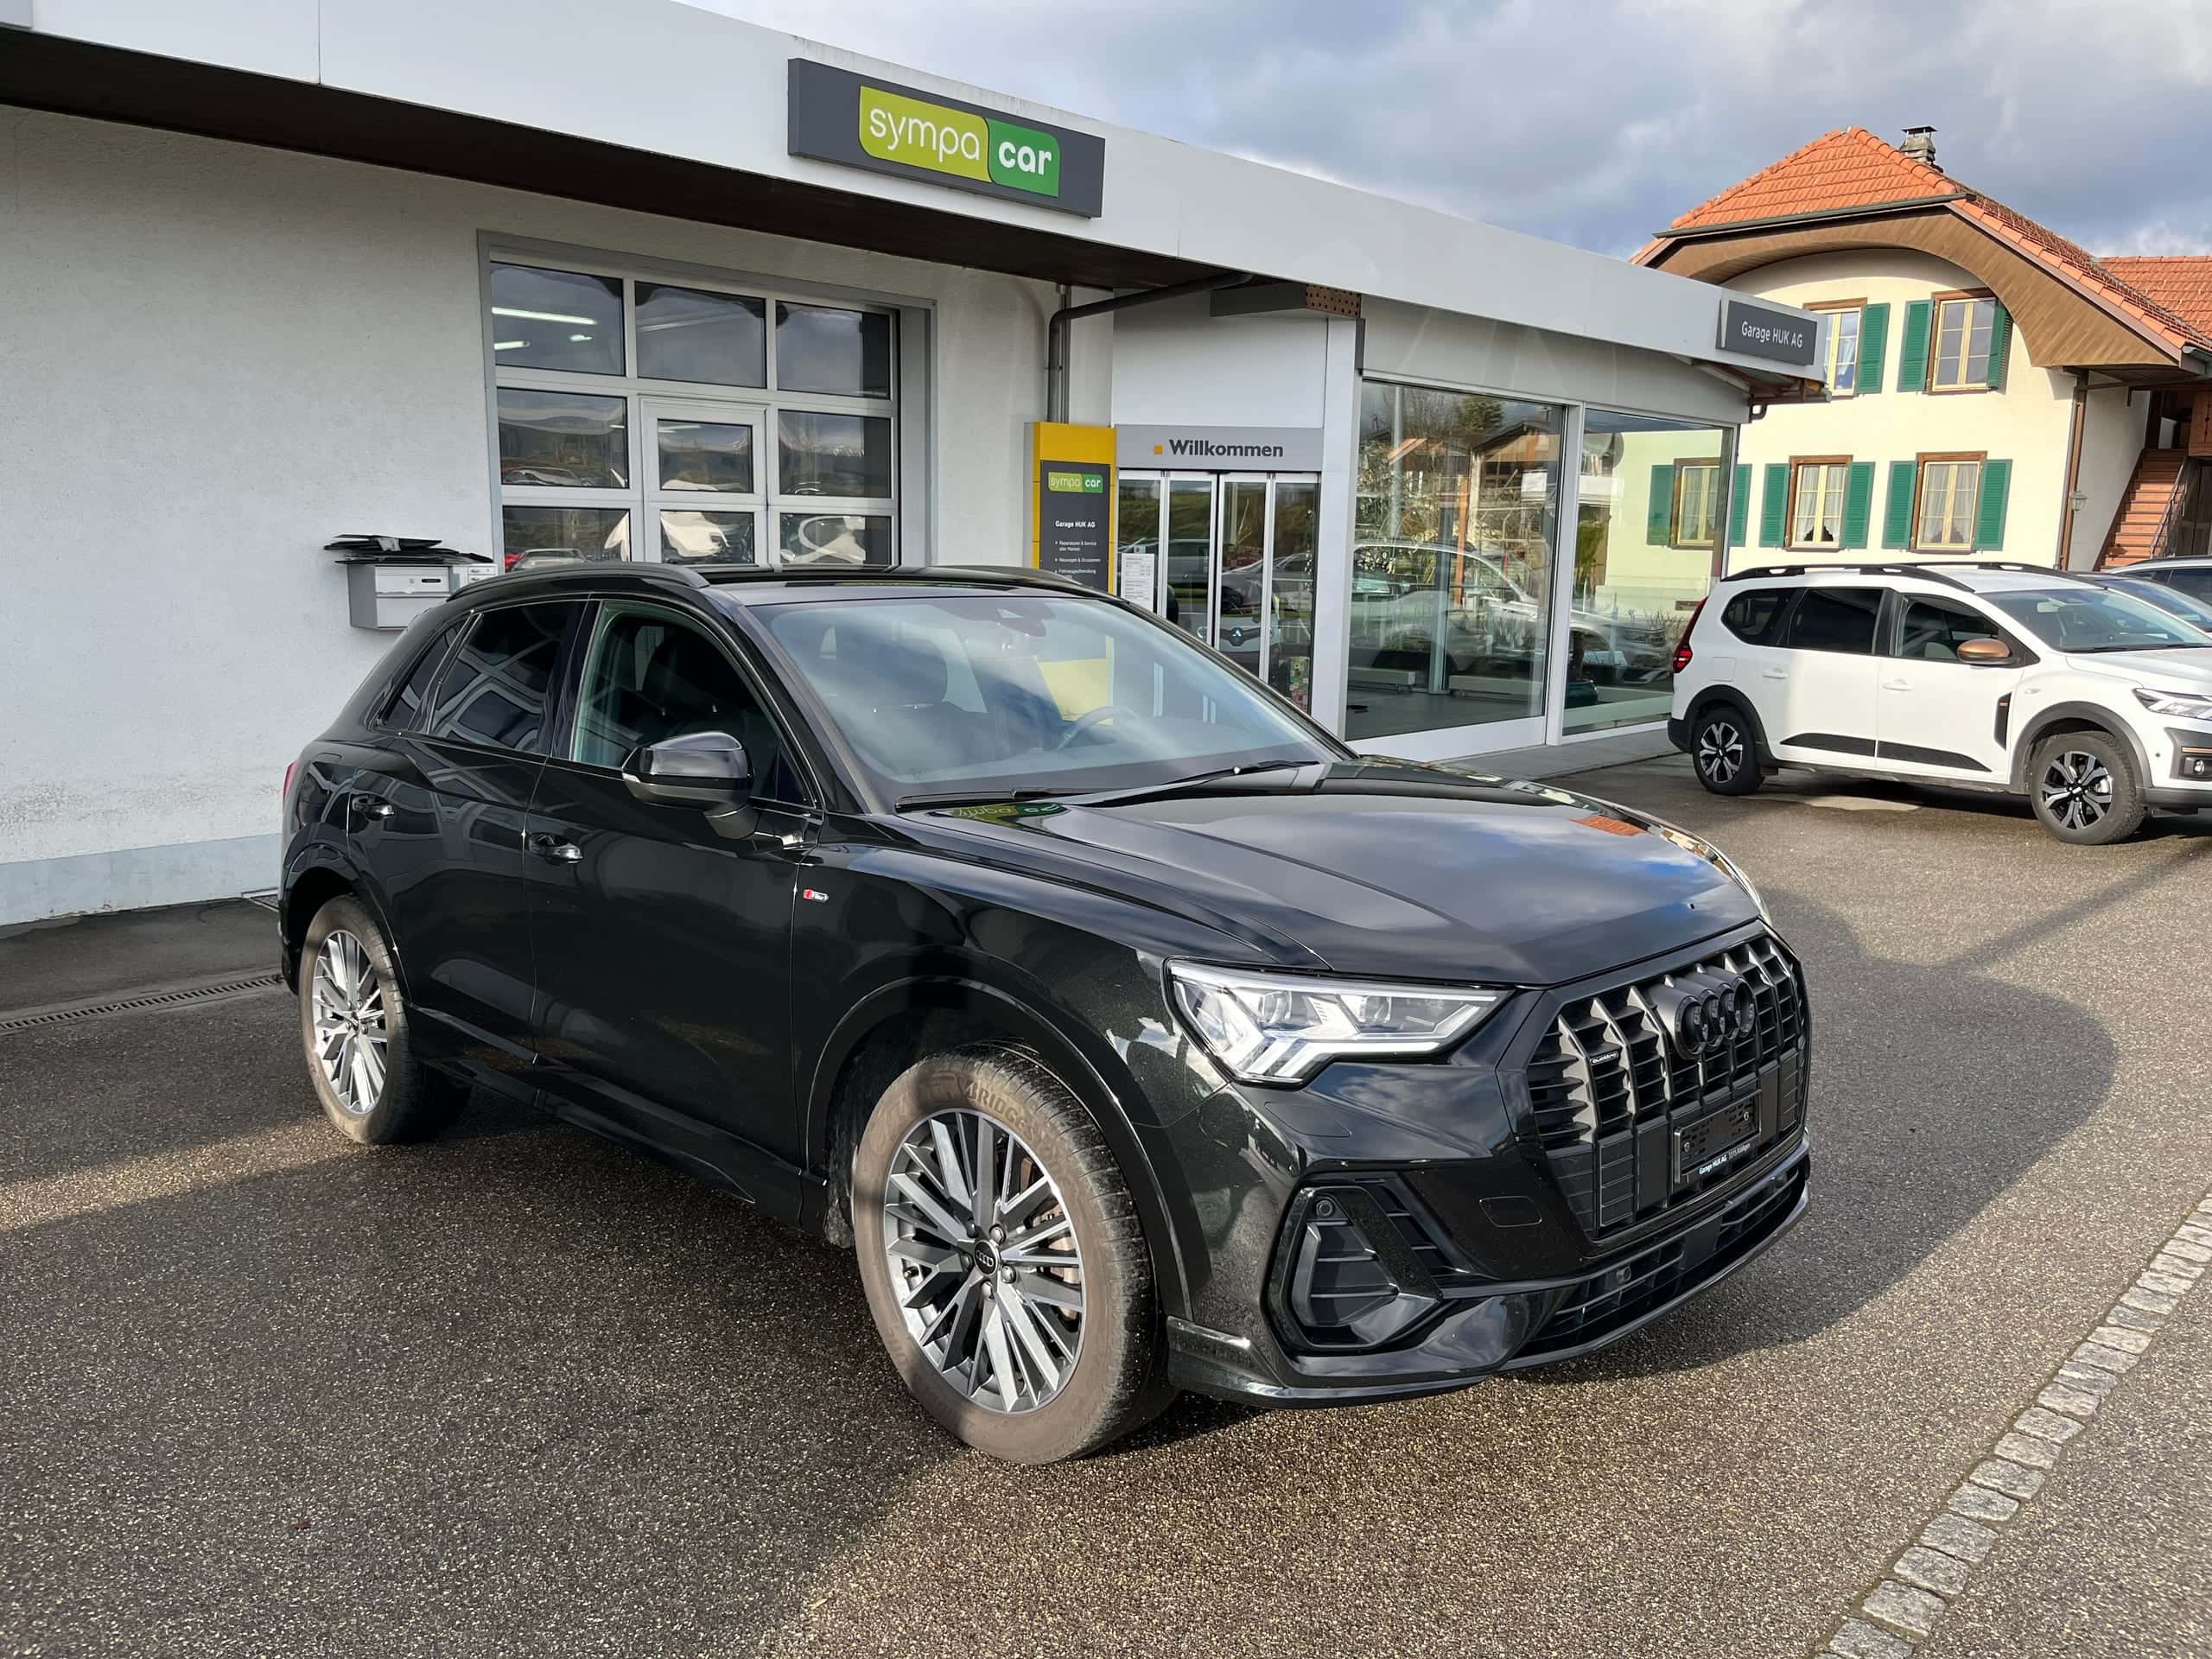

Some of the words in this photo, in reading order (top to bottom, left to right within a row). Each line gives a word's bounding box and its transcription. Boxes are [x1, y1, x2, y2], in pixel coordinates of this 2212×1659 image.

[870, 108, 980, 162] sympa
[998, 141, 1052, 175] car
[1741, 321, 1770, 342] Garage
[1772, 327, 1790, 345] HUK
[1791, 333, 1802, 347] AG
[1169, 439, 1284, 457] Willkommen
[1051, 477, 1079, 489] sympa
[1084, 479, 1101, 488] car
[1055, 520, 1074, 529] Garage
[1699, 1164, 1713, 1175] Garage
